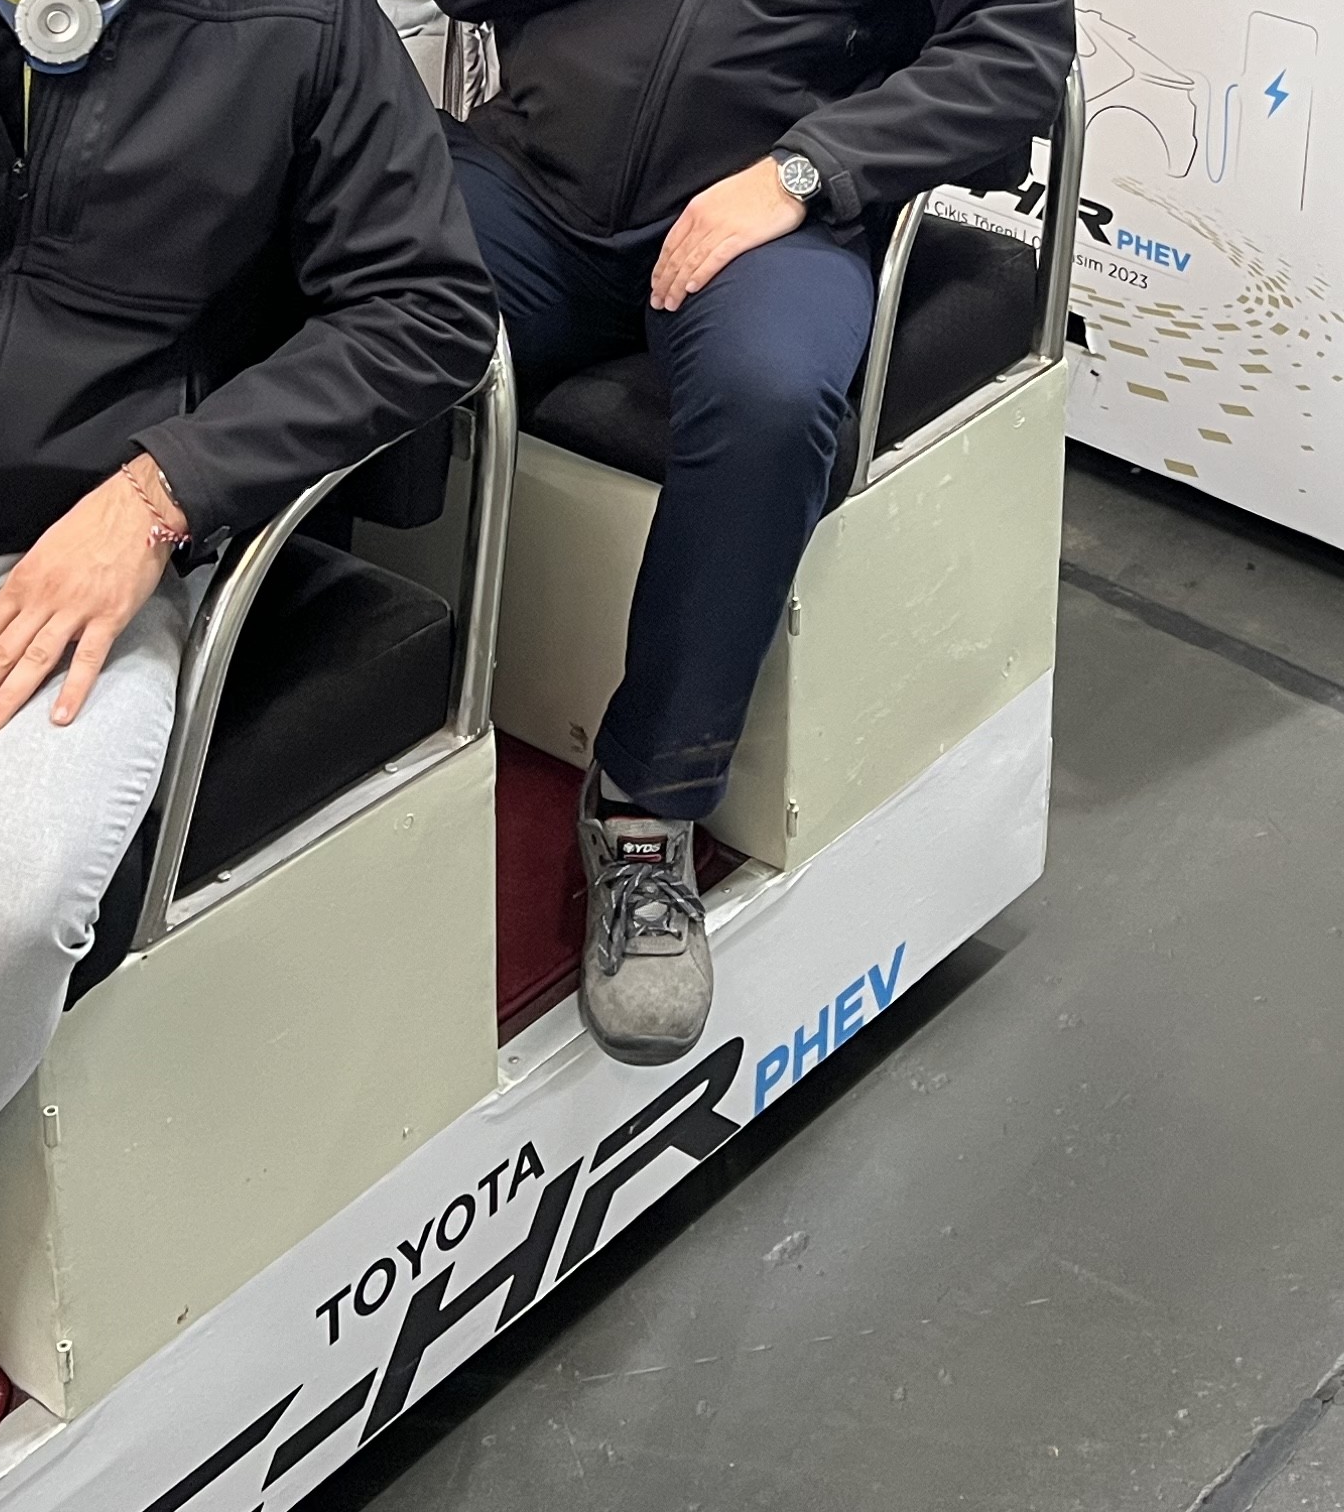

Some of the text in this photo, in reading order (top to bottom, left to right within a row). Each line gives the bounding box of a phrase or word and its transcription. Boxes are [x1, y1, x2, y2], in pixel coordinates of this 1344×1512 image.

[1116, 228, 1192, 273] PHEV
[1108, 262, 1149, 290] 2023
[635, 843, 662, 853] YDS
[754, 942, 908, 1114] PHEV
[315, 1141, 546, 1346] TOYOTA
